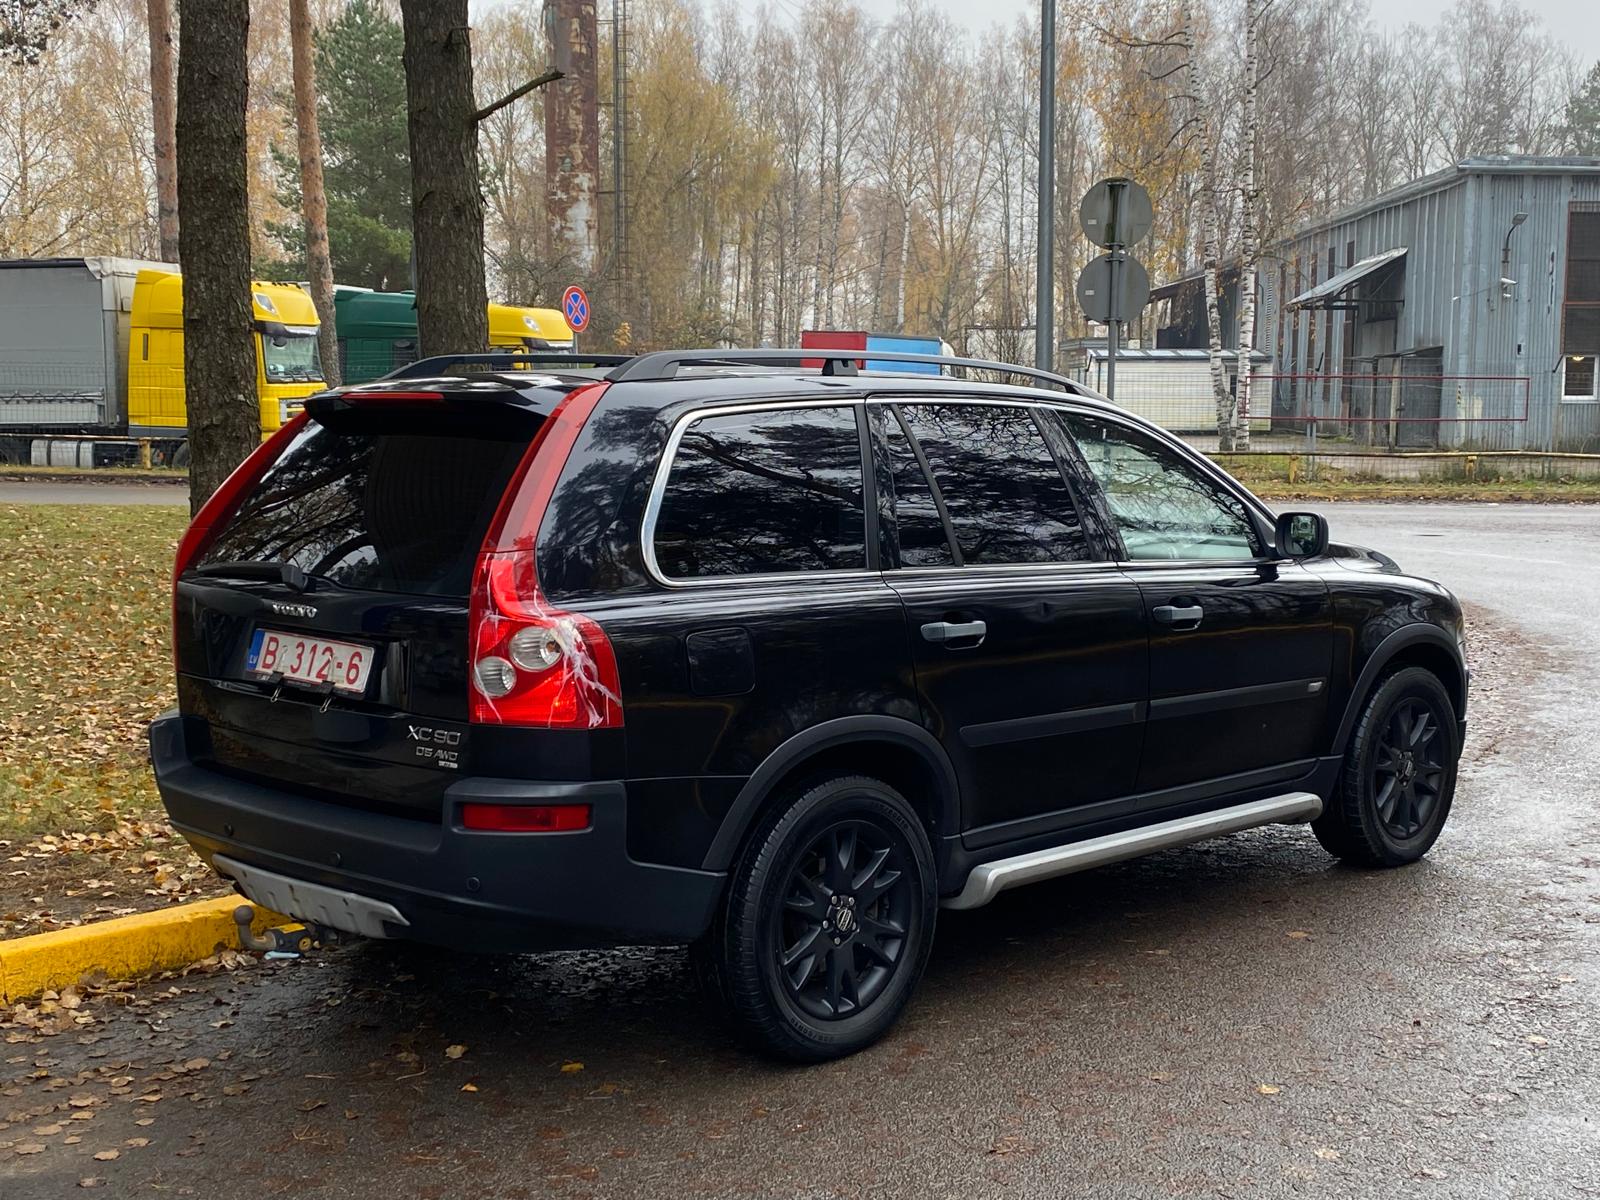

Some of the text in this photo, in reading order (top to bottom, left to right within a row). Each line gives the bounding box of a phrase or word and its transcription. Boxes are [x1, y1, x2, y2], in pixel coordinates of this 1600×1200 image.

[272, 602, 318, 618] VOLVO
[261, 636, 363, 685] B 312-6
[433, 749, 459, 761] AWD
